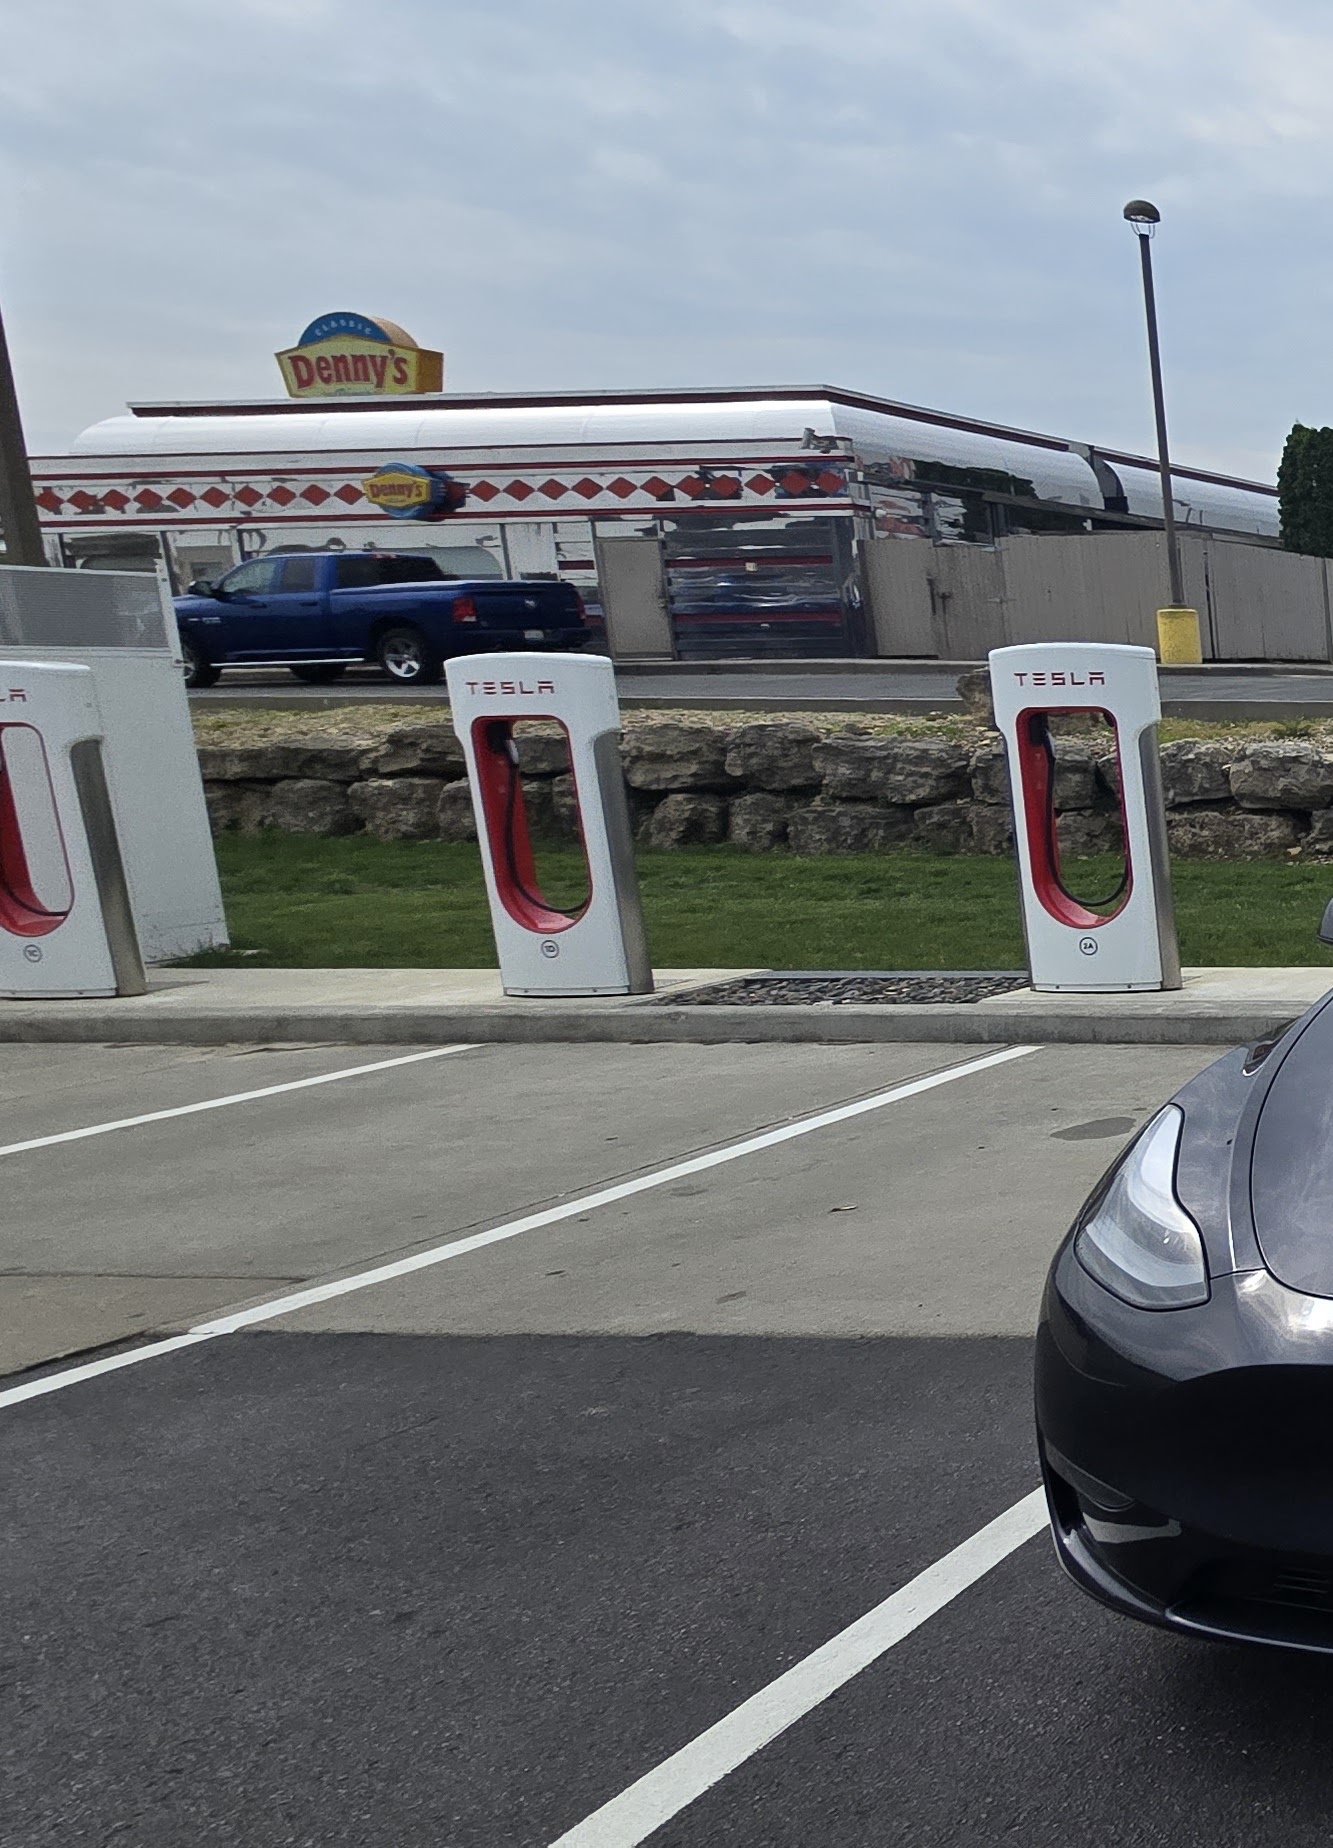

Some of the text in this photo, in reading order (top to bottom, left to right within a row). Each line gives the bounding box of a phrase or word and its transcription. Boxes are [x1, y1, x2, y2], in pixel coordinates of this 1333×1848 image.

[287, 348, 408, 389] Denny's
[1013, 671, 1105, 686] TESLA
[465, 680, 555, 695] TESLA
[1083, 942, 1094, 950] 2A
